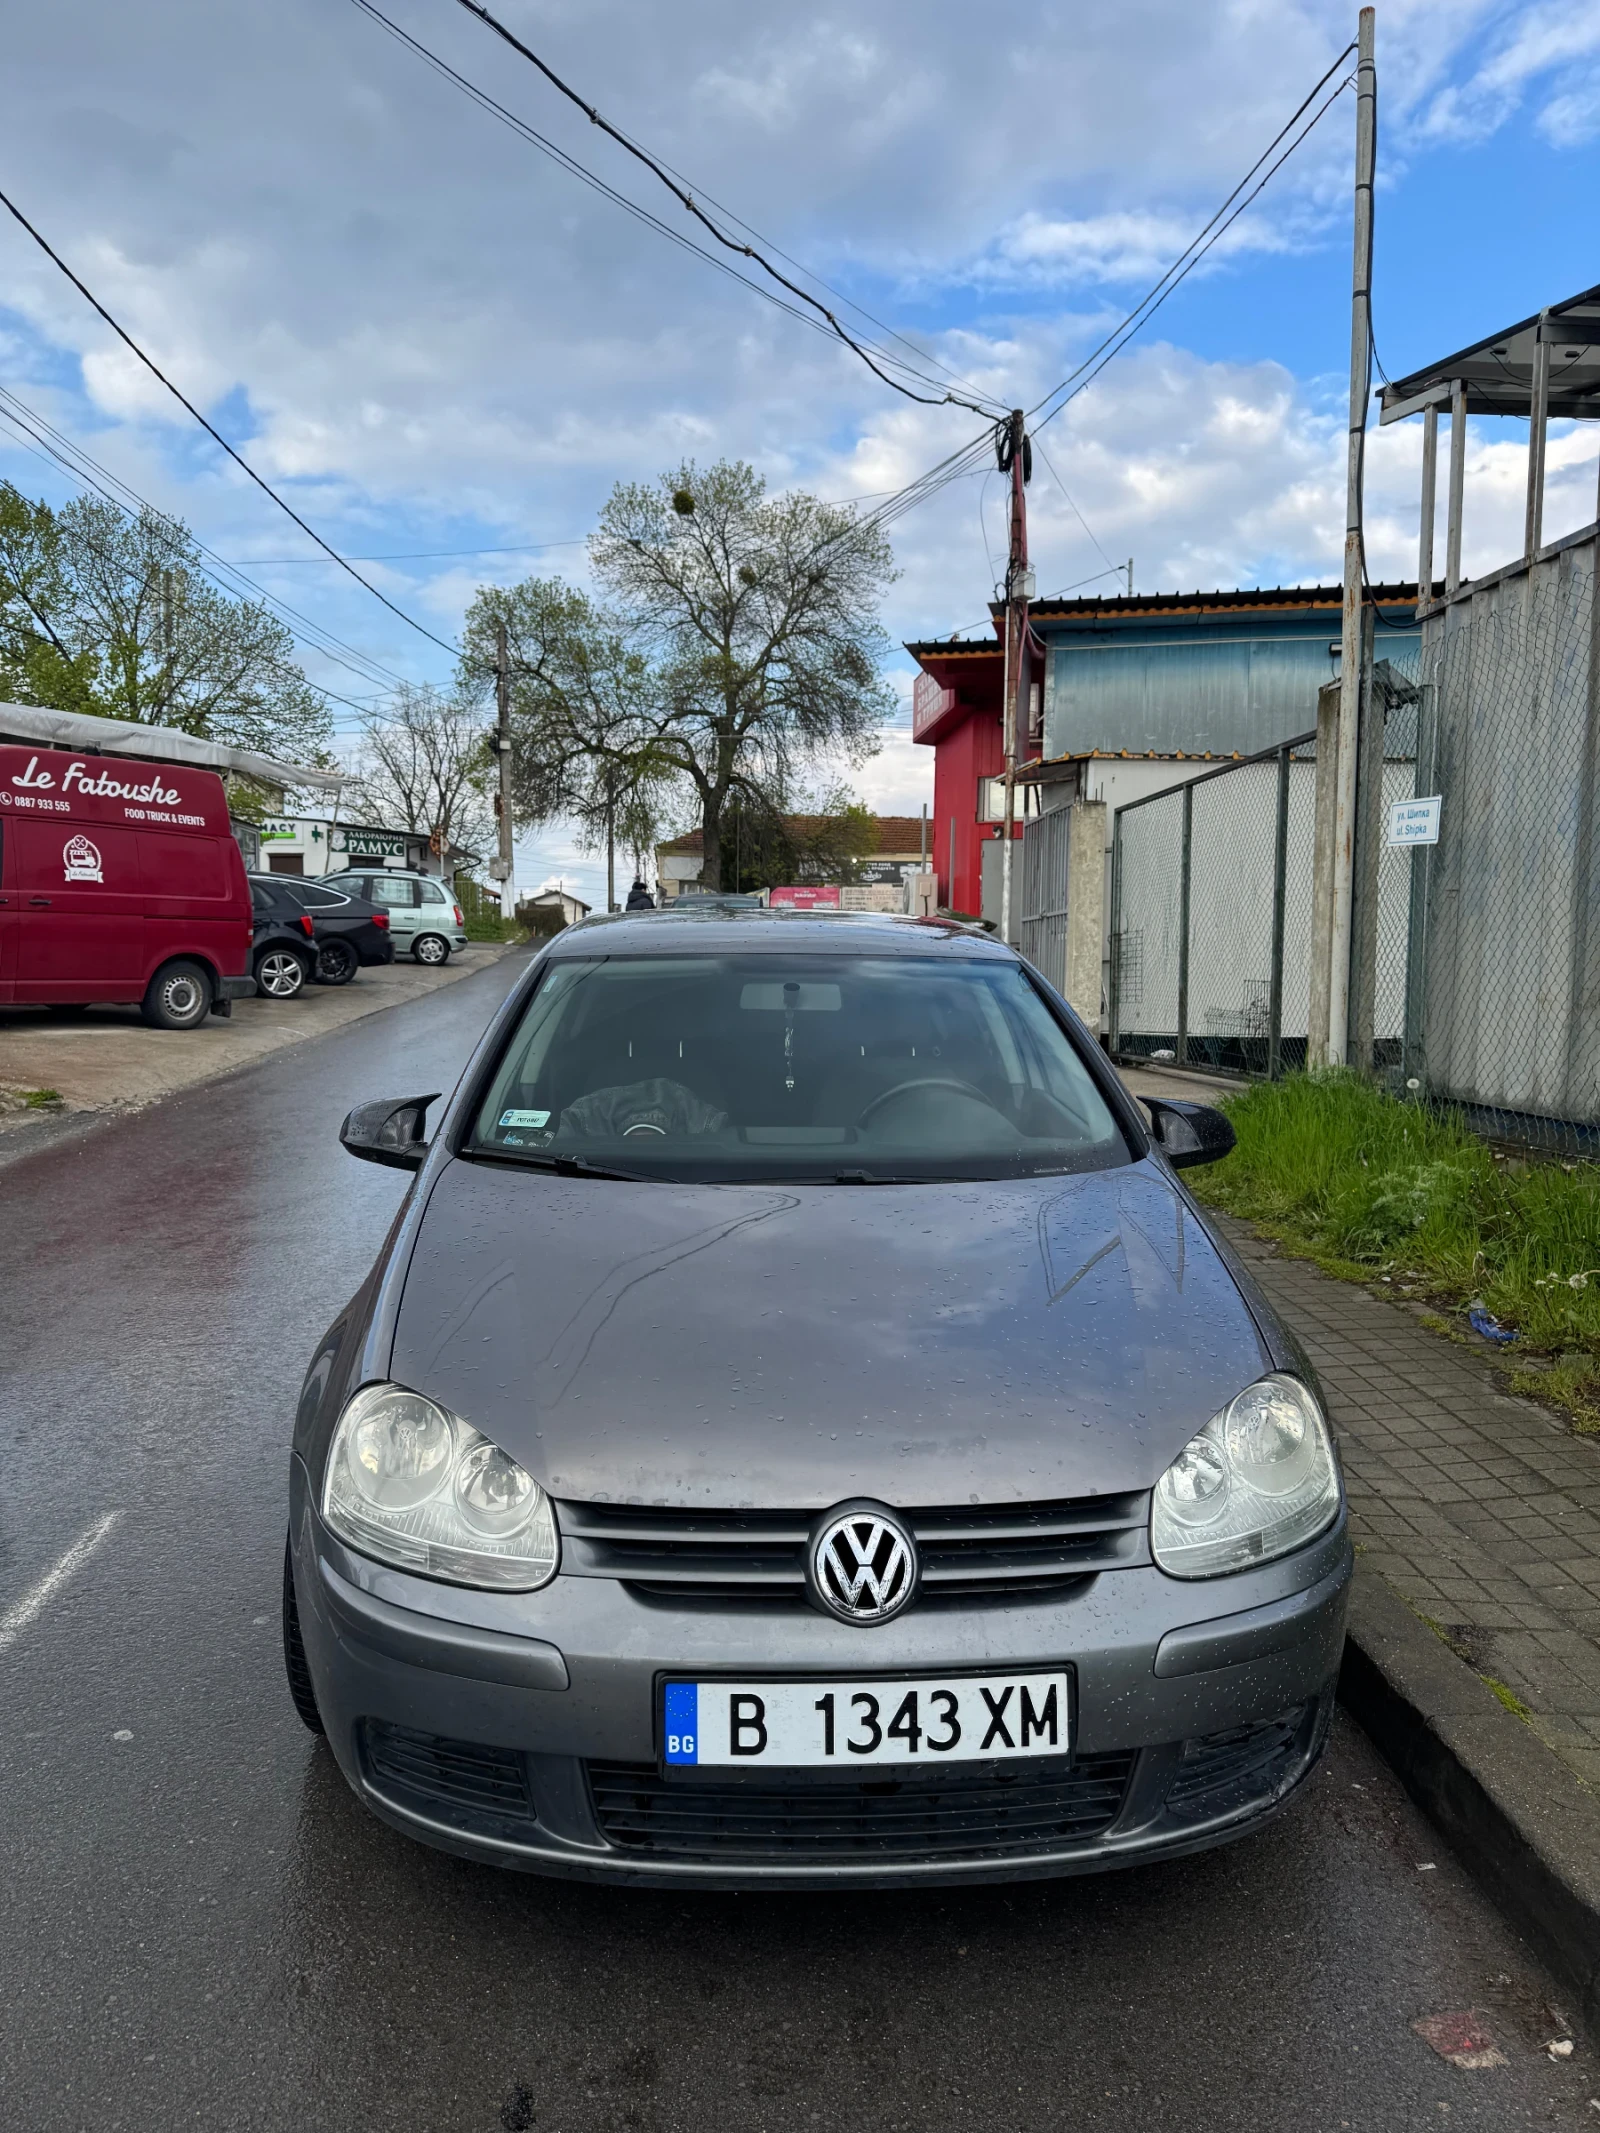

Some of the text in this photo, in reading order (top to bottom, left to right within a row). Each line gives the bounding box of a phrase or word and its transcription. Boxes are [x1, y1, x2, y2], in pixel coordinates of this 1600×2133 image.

[12, 756, 182, 805] Le Fatoushe
[14, 796, 70, 812] 0887 933 555
[124, 808, 206, 826] FOOD TRUCK & EVENTS
[1407, 808, 1430, 820] Шипка
[259, 823, 296, 832] MACY
[349, 831, 404, 841] ЛАБОРАТОРИЯ
[1396, 823, 1427, 837] ul. Shipka
[348, 839, 404, 856] РАМУС
[818, 1515, 910, 1614] VW
[729, 1684, 1058, 1756] B 1343 XM
[668, 1735, 694, 1753] BG
